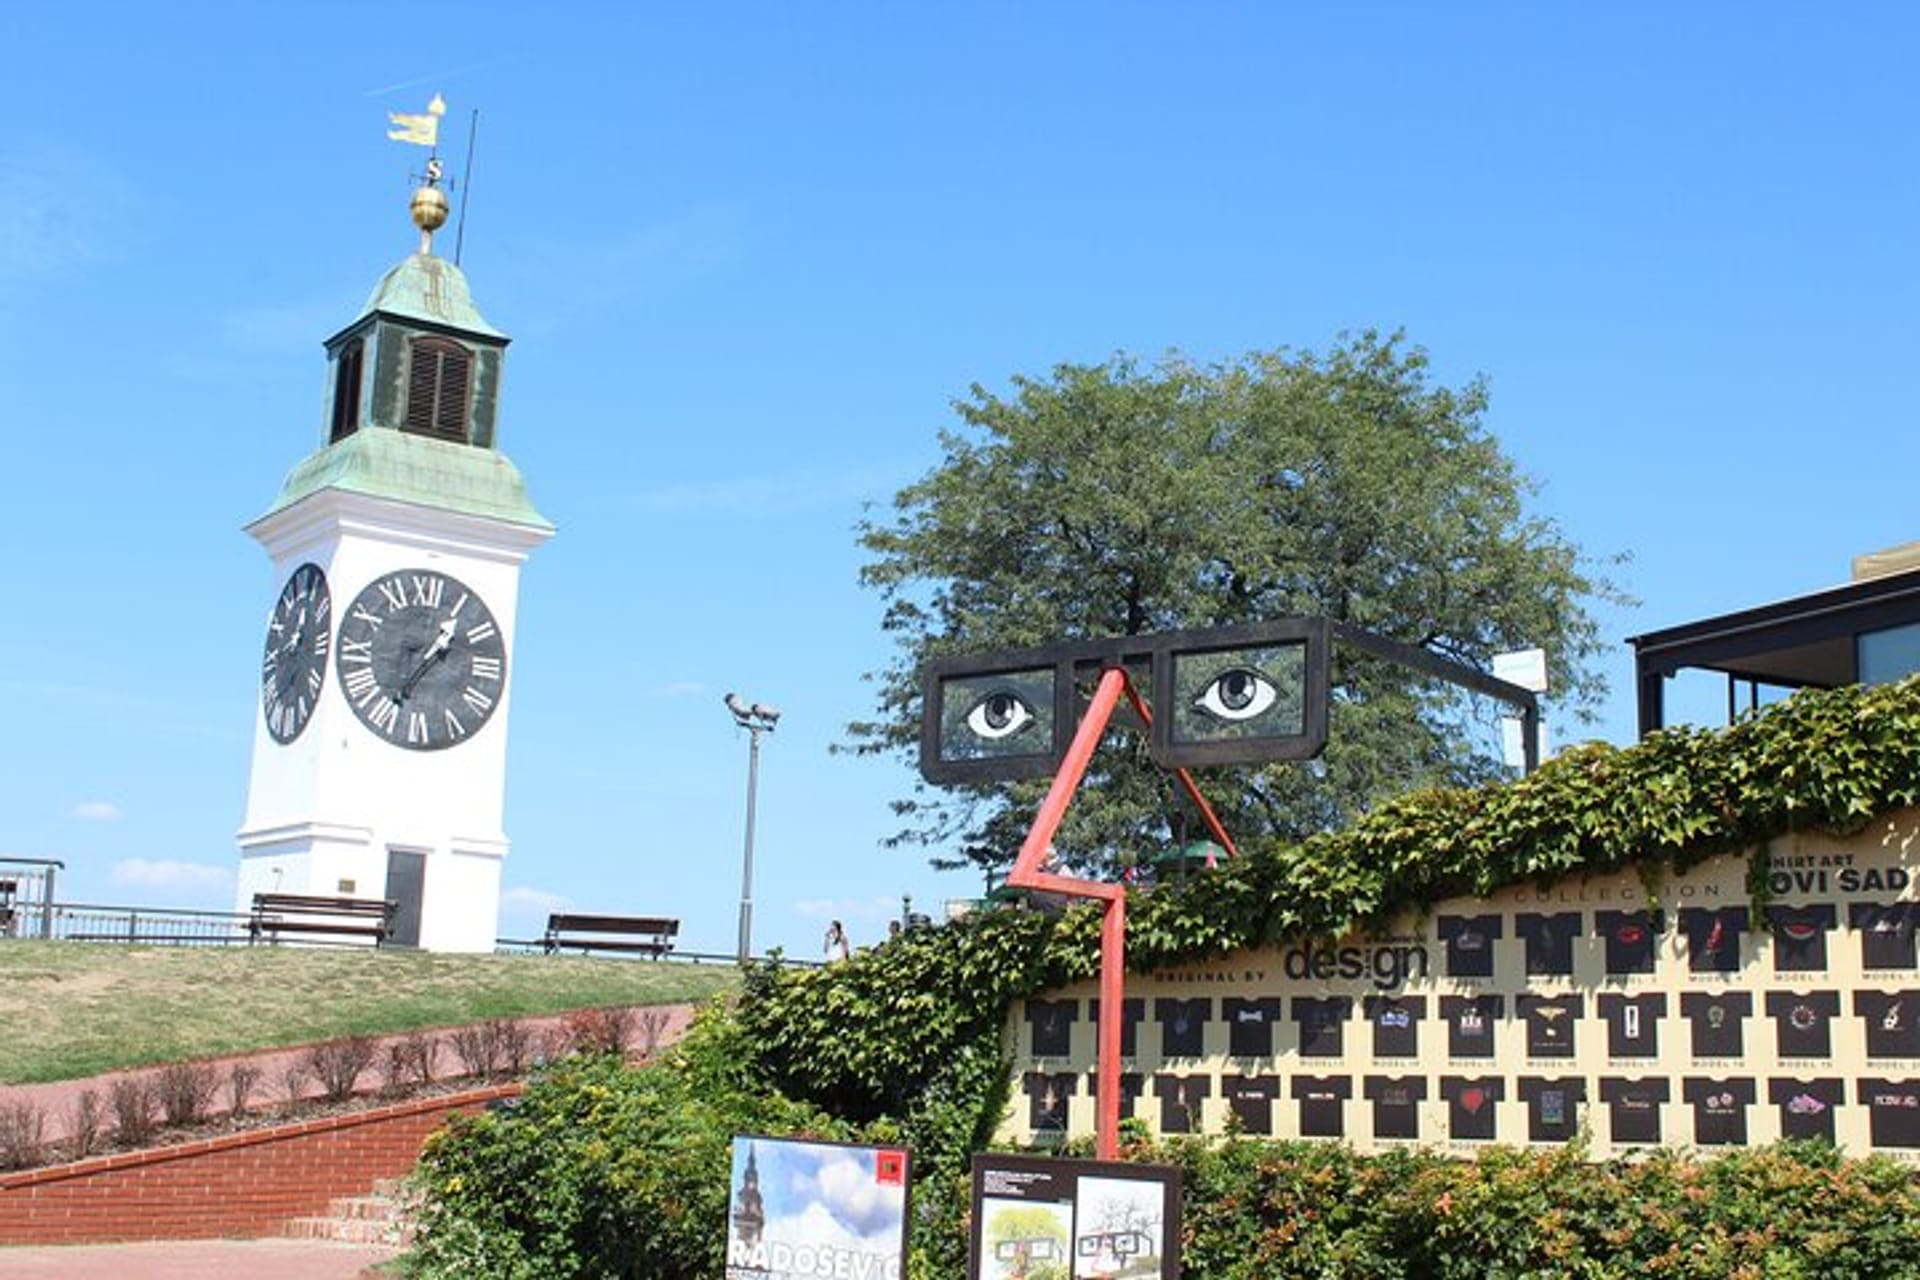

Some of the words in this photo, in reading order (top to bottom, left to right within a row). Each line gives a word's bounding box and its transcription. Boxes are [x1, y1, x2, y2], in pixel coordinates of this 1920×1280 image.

[427, 160, 442, 180] S
[378, 577, 408, 613] XI
[412, 575, 444, 608] XII
[450, 592, 469, 617] I
[352, 602, 383, 632] X
[466, 621, 496, 644] II
[342, 636, 372, 663] IX
[472, 656, 500, 680] III
[344, 667, 380, 709] VIII
[461, 686, 493, 718] IV
[368, 696, 400, 735] VII
[407, 712, 429, 744] VI
[444, 709, 466, 739] V
[1819, 854, 1855, 867] ART
[1513, 884, 1721, 902] COLLECION
[1745, 870, 1828, 895] OVI
[1838, 867, 1909, 892] SAD
[1153, 970, 1236, 982] ORIGINAL
[1245, 971, 1265, 982] BY
